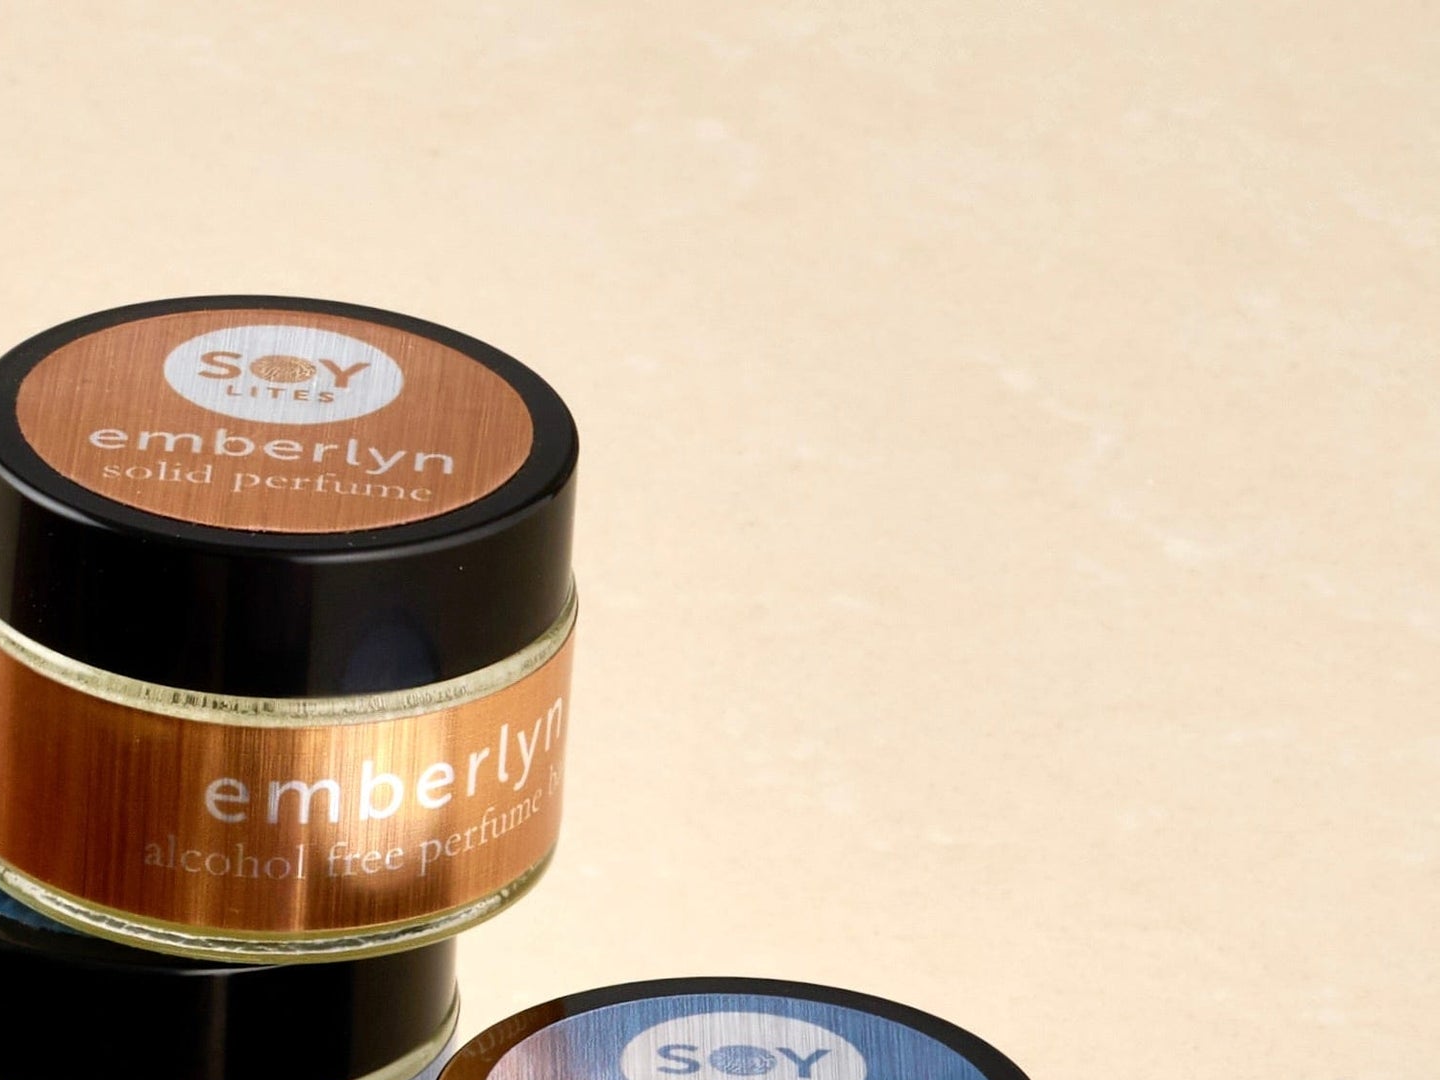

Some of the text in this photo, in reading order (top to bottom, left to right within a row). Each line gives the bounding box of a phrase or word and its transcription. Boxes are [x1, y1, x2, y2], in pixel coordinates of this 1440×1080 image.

[198, 351, 371, 389] SOY
[226, 385, 335, 402] LITES
[88, 428, 454, 475] emberlyn
[103, 460, 432, 501] solid perfume
[204, 696, 562, 825] emberlyn
[144, 797, 540, 879] alcohol free perfume
[655, 1044, 831, 1078] SOY
